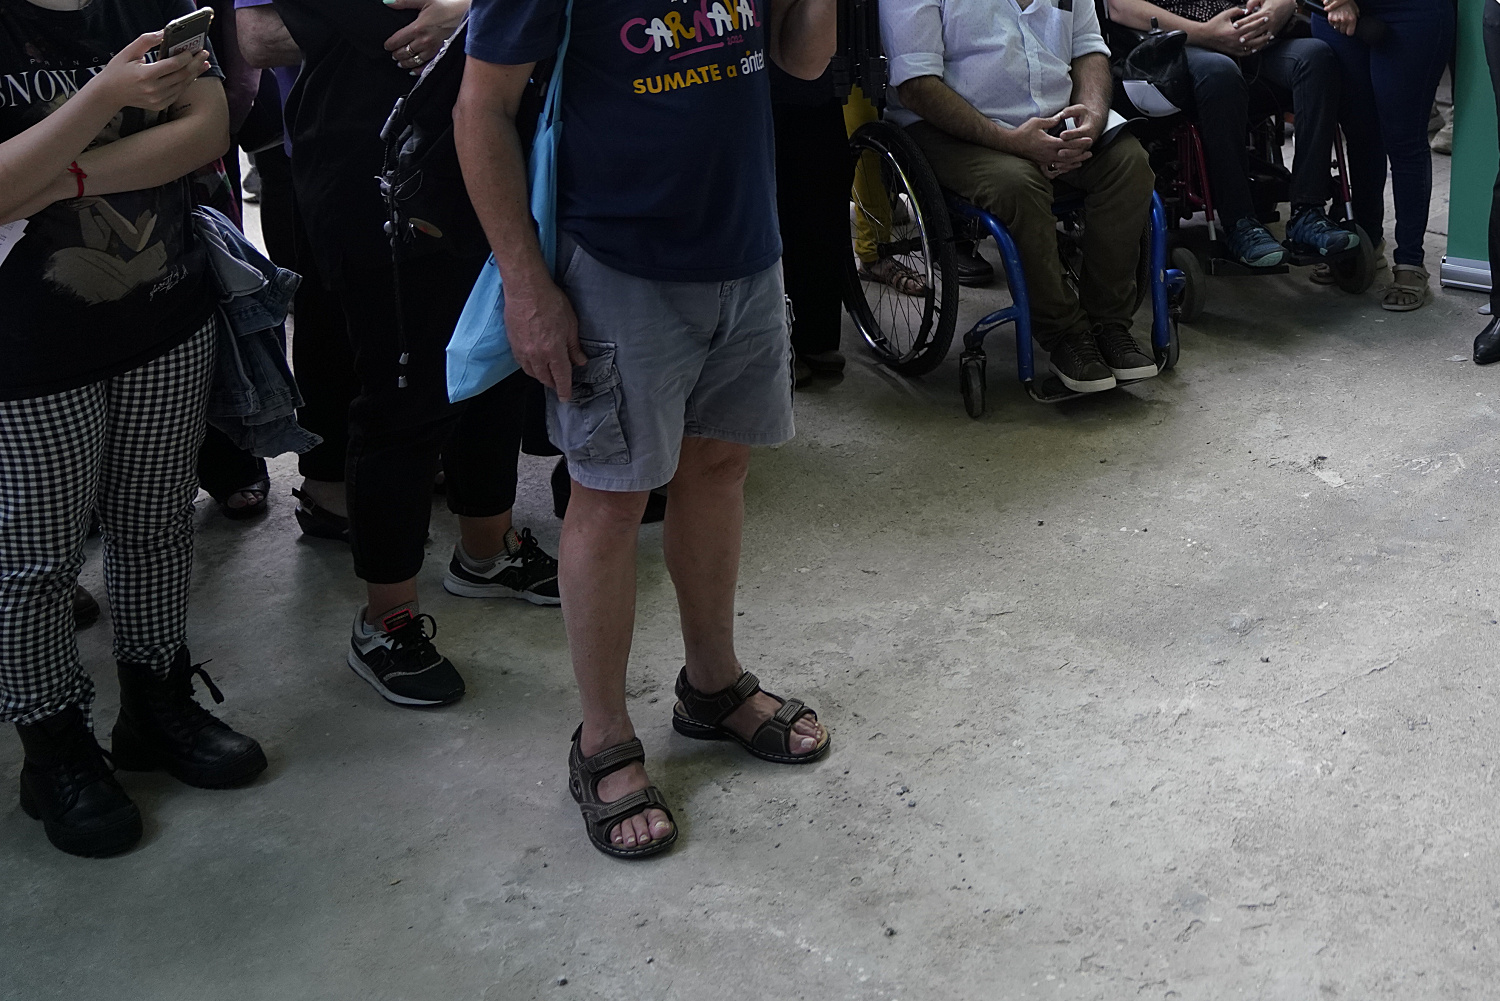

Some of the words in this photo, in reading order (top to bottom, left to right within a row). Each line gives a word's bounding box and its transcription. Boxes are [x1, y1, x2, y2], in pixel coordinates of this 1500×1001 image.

[633, 64, 721, 94] SUMATE
[727, 65, 738, 78] a
[740, 49, 765, 75] antel
